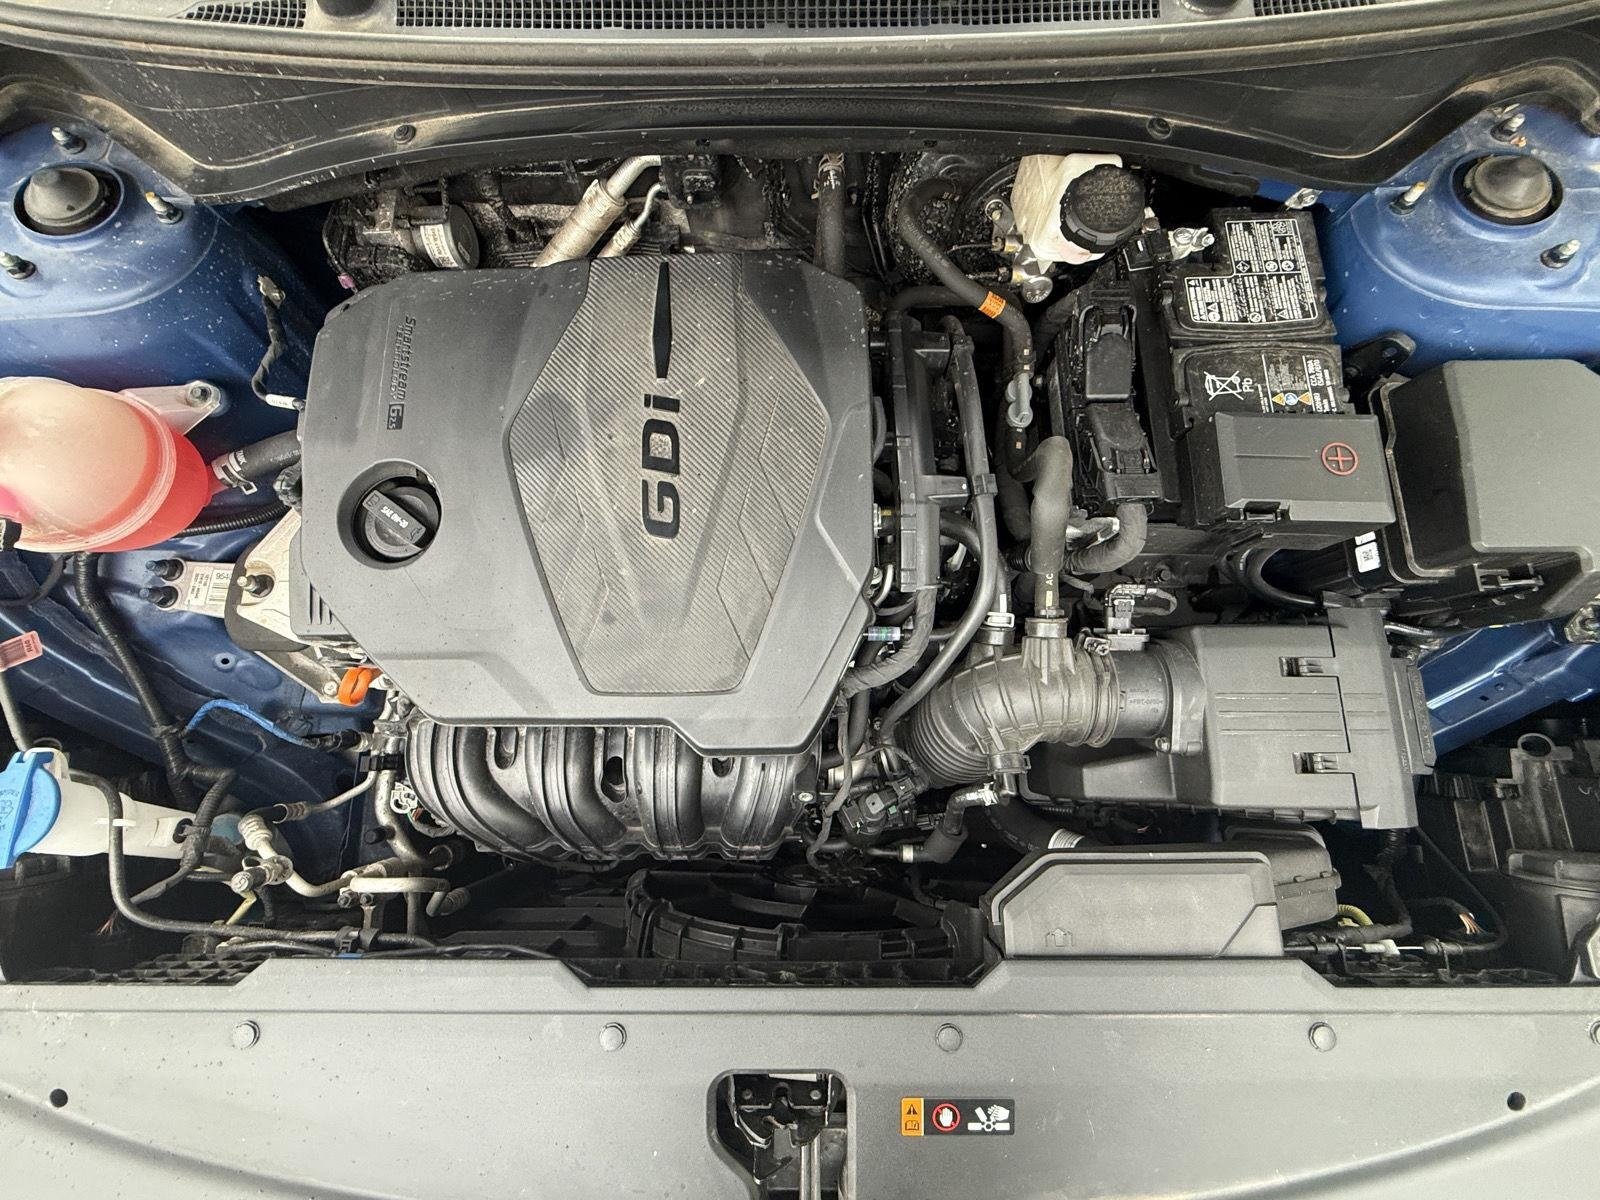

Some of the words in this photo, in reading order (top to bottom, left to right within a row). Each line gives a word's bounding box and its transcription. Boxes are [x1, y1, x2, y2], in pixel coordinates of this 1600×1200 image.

[396, 315, 416, 400] Smartstream
[1241, 377, 1254, 393] Pb
[641, 393, 681, 540] GDi
[380, 505, 394, 518] SAE
[390, 513, 408, 528] 0W-20
[1045, 573, 1053, 585] AC
